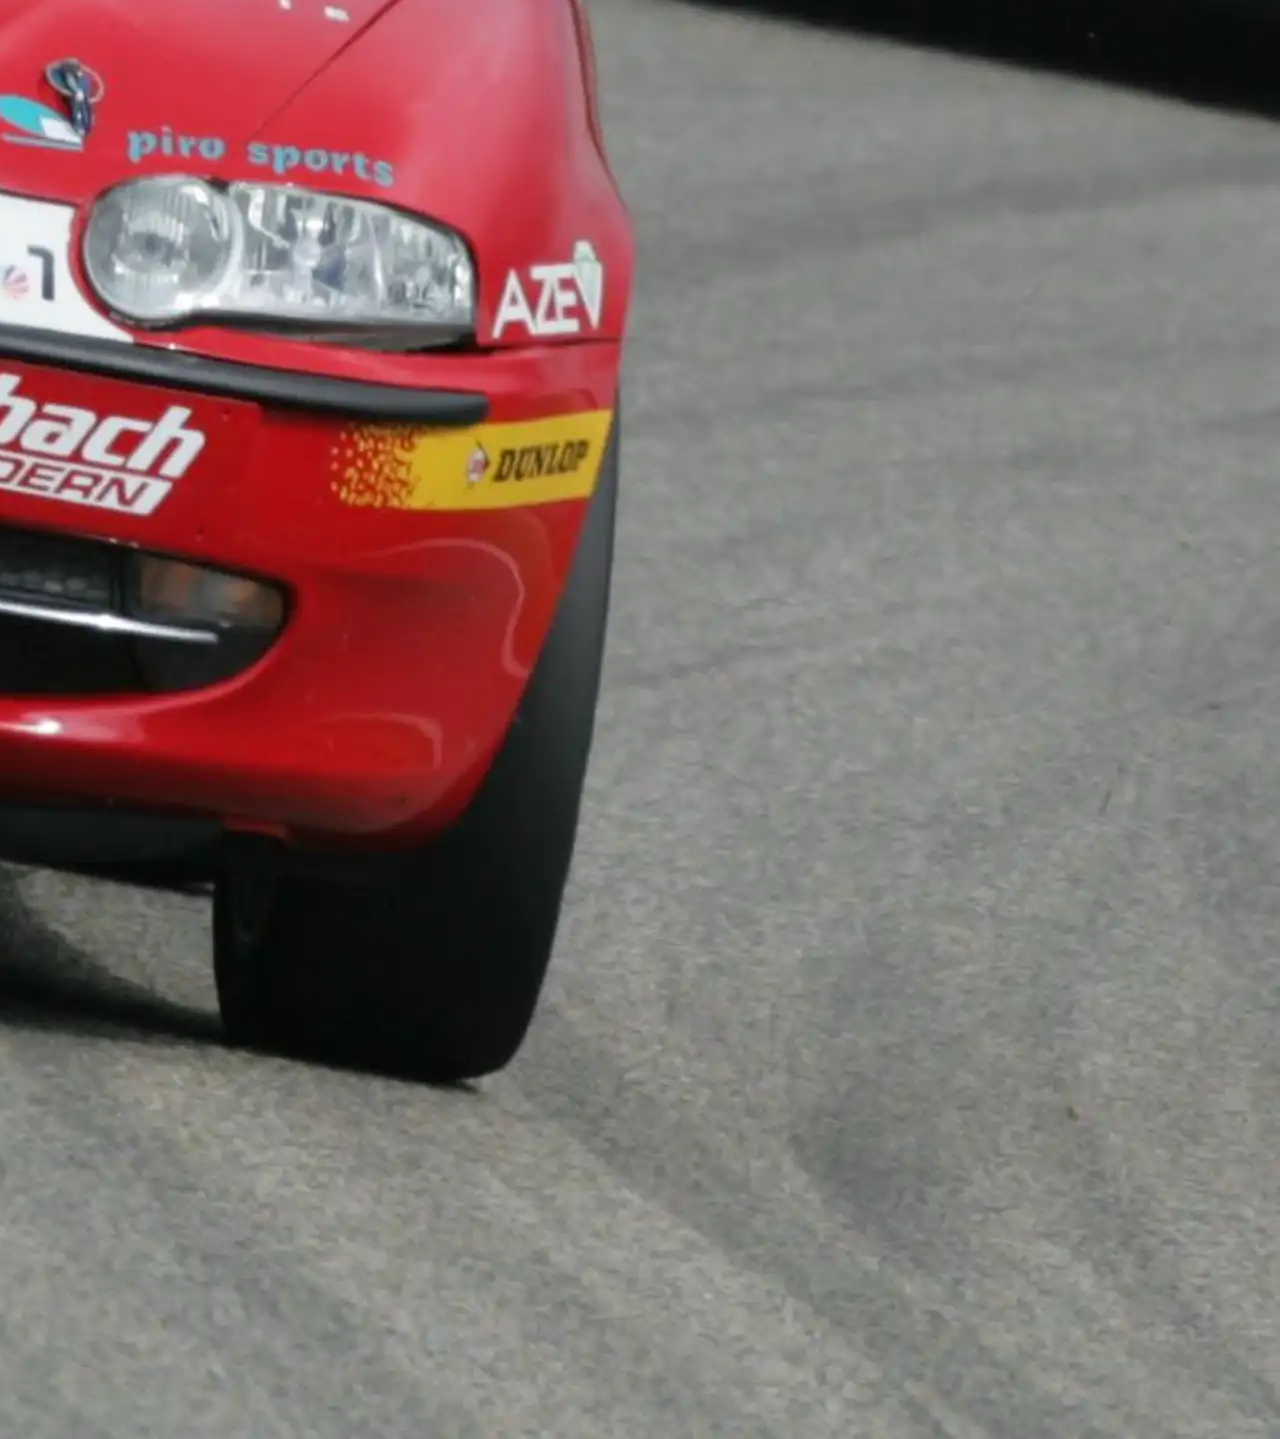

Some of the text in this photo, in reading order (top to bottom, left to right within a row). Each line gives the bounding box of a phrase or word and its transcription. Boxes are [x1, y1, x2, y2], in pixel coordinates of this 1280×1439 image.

[127, 125, 395, 187] piro sports
[492, 439, 592, 483] DUNLOP
